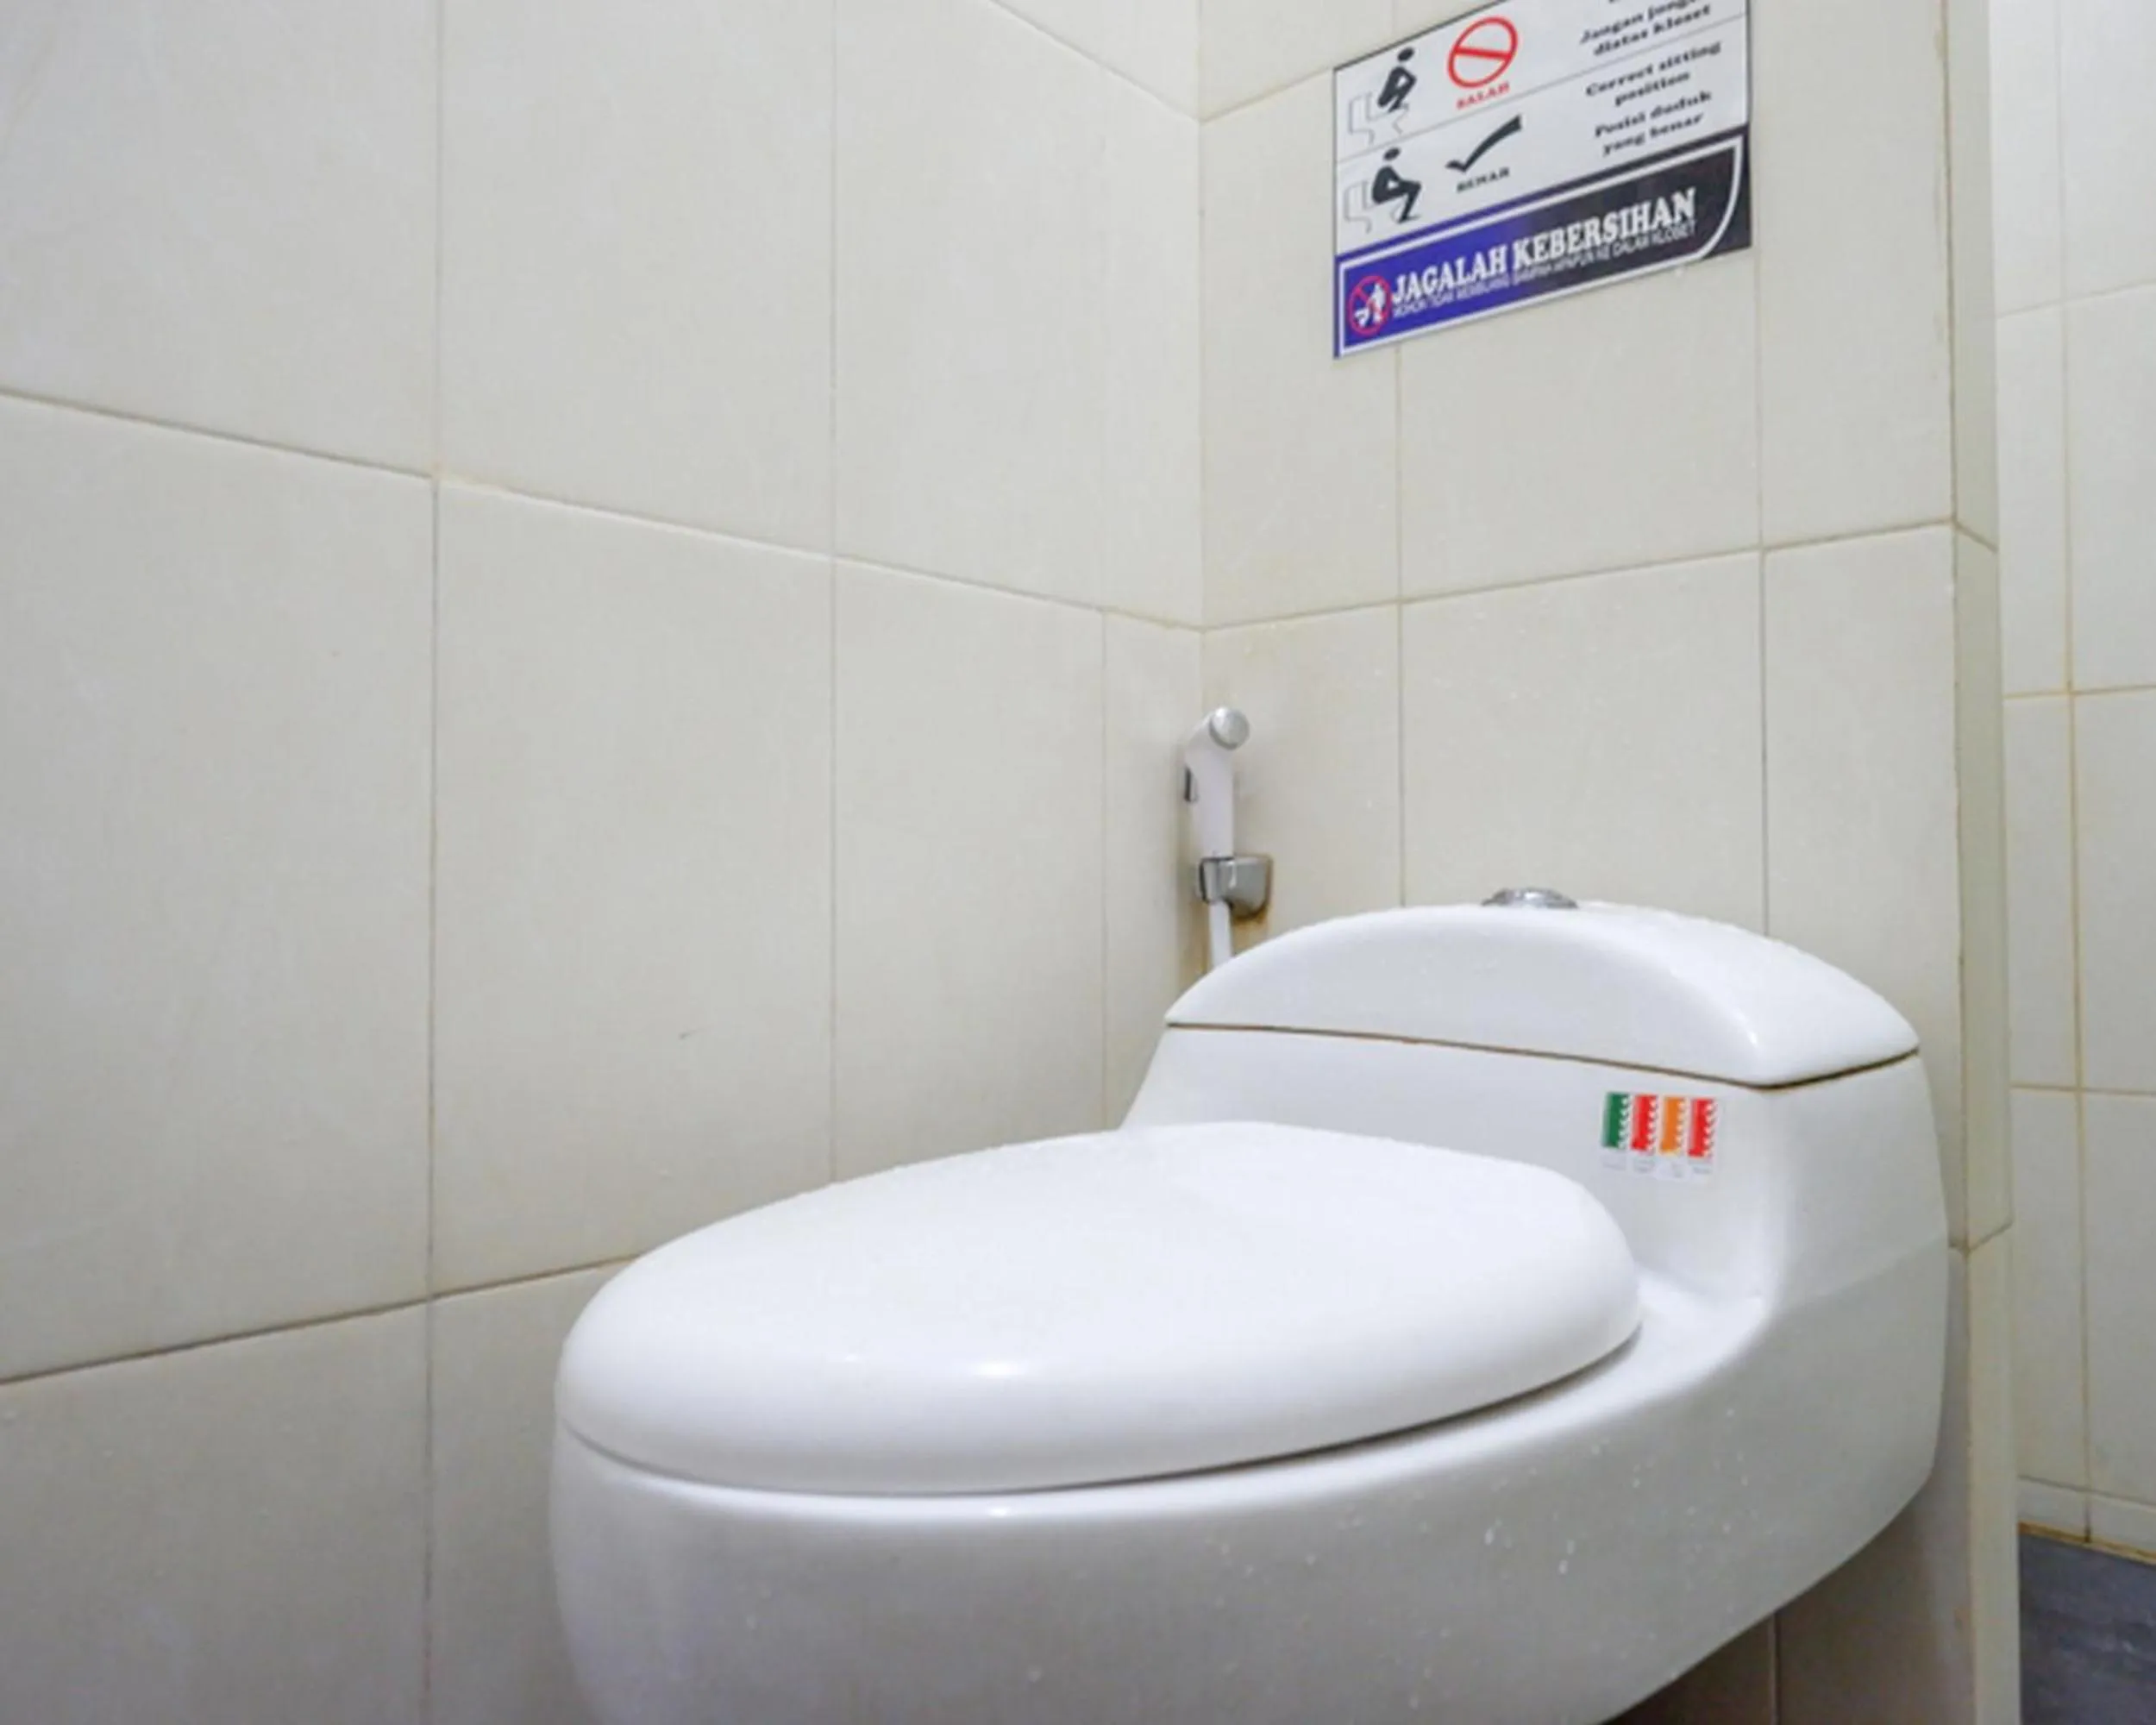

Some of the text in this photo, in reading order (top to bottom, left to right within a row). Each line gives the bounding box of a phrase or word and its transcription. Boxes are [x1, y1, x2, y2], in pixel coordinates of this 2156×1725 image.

[1579, 13, 1644, 44] Jangan
[1594, 3, 1710, 56] diatas kloset
[1585, 41, 1722, 97] Correct sitting
[1614, 72, 1690, 107] position
[1456, 81, 1510, 110] SALAH
[1595, 90, 1712, 138] Posisi duduk
[1603, 112, 1704, 156] yang benar
[1456, 166, 1510, 192] BENAR
[1393, 243, 1508, 303] JAGALAH
[1513, 186, 1696, 271] KEBERSIHAN
